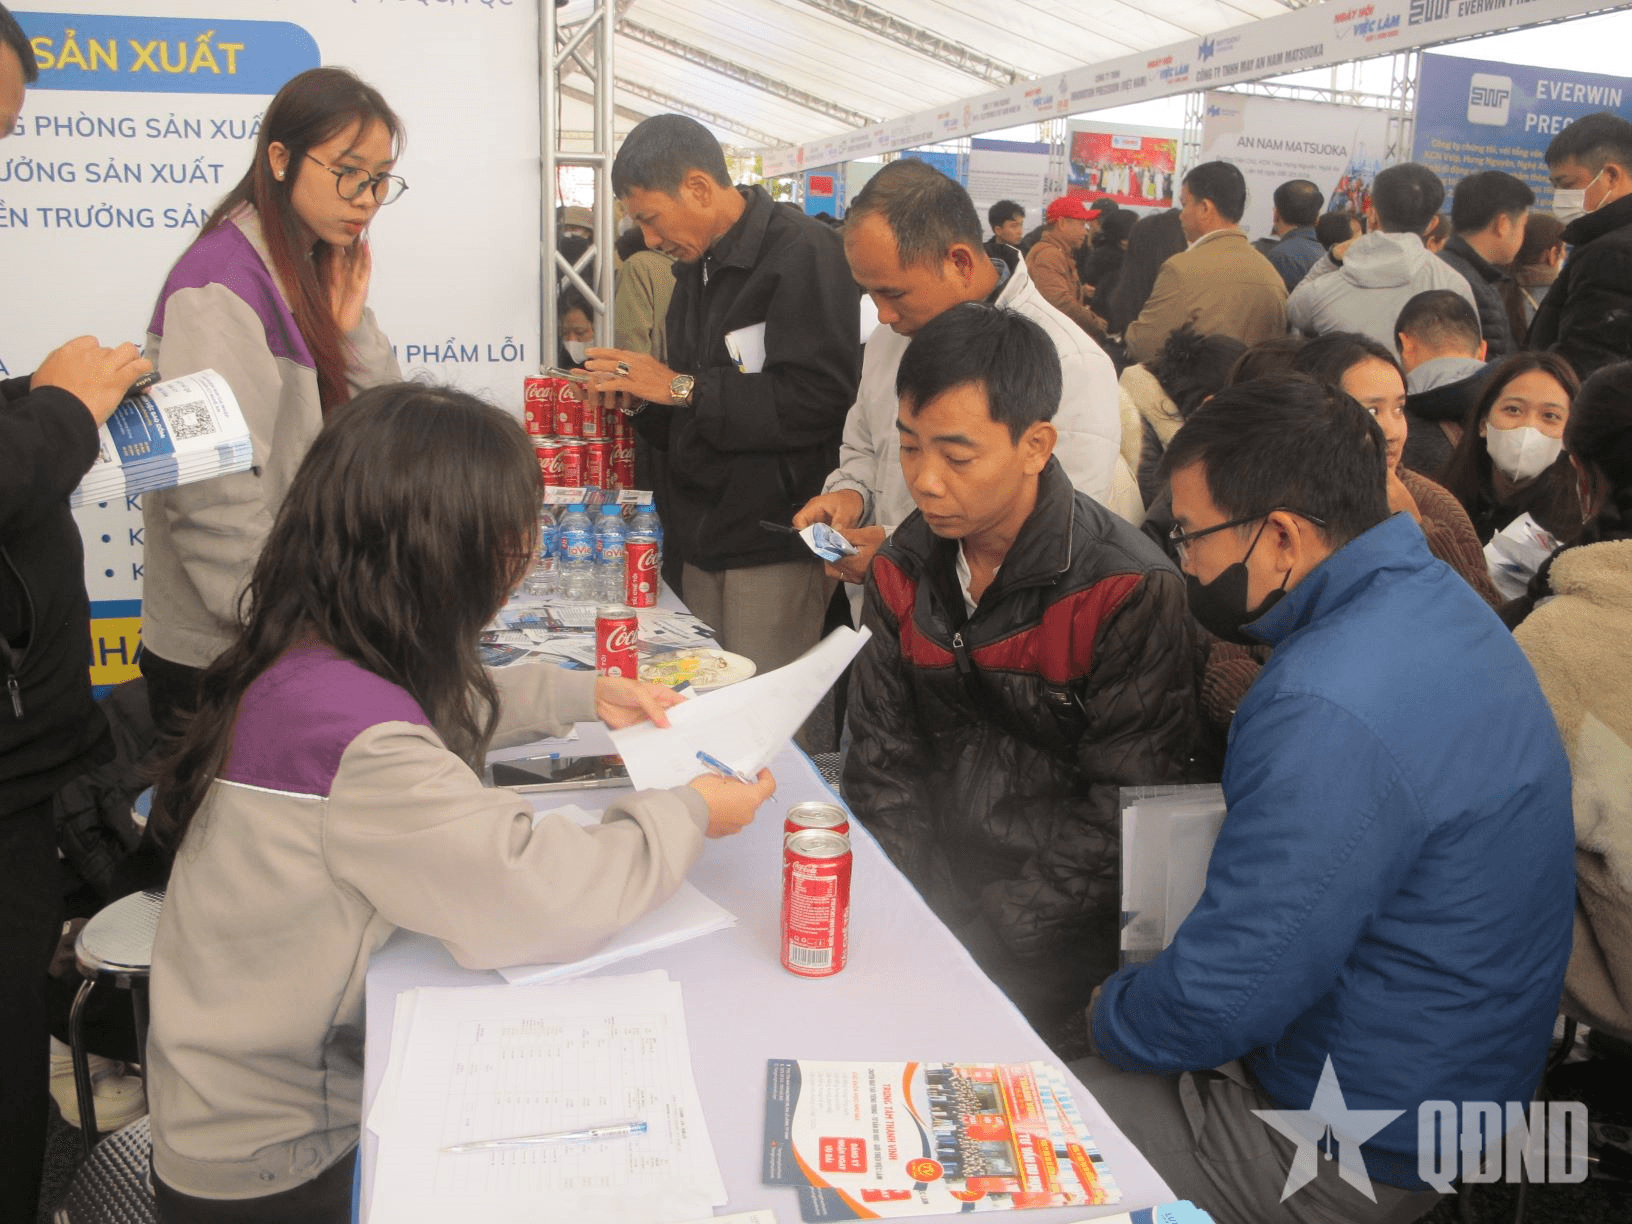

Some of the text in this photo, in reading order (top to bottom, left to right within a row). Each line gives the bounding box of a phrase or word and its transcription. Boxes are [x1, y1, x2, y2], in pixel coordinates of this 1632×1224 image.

[1377, 14, 1400, 31] LÀM
[31, 28, 245, 74] SẢN XUẤT
[1240, 59, 1254, 73] MAY
[1255, 57, 1266, 70] AN
[1266, 51, 1284, 68] NAM
[1284, 43, 1324, 64] MATSUOKA
[1536, 79, 1623, 107] EVERWIN
[35, 111, 136, 138] PHÒNG
[146, 112, 201, 139] SẢN
[210, 111, 263, 139] XUẤ
[1237, 136, 1348, 157] AN NAM MATSUOKA
[85, 157, 142, 183] SẢN
[150, 156, 224, 184] XUẤT
[36, 202, 154, 228] TRƯỞNG
[406, 337, 478, 363] PHẨM
[487, 336, 524, 362] LỖI
[883, 1106, 896, 1120] TÂM
